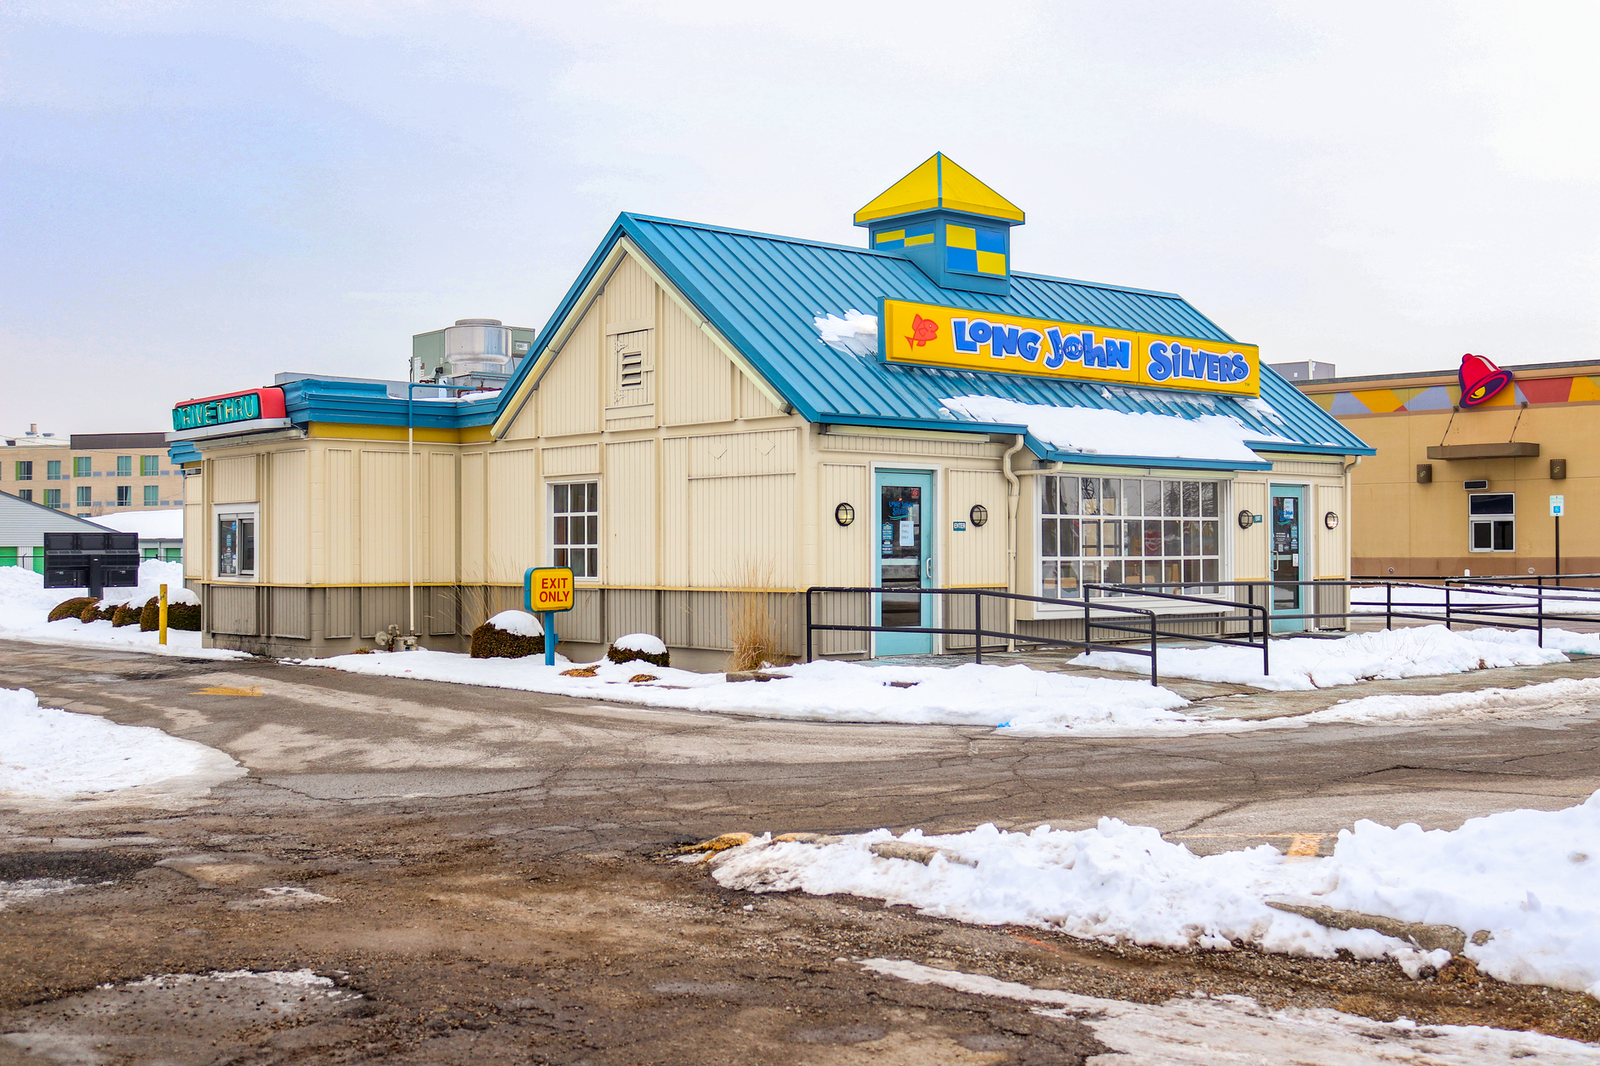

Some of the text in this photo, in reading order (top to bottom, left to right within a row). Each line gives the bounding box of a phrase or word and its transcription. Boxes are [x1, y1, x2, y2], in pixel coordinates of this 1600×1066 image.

[952, 319, 1043, 362] LONG
[172, 395, 259, 430] DRIVE THRU
[541, 578, 568, 589] EXIT
[539, 591, 570, 602] ONLY
